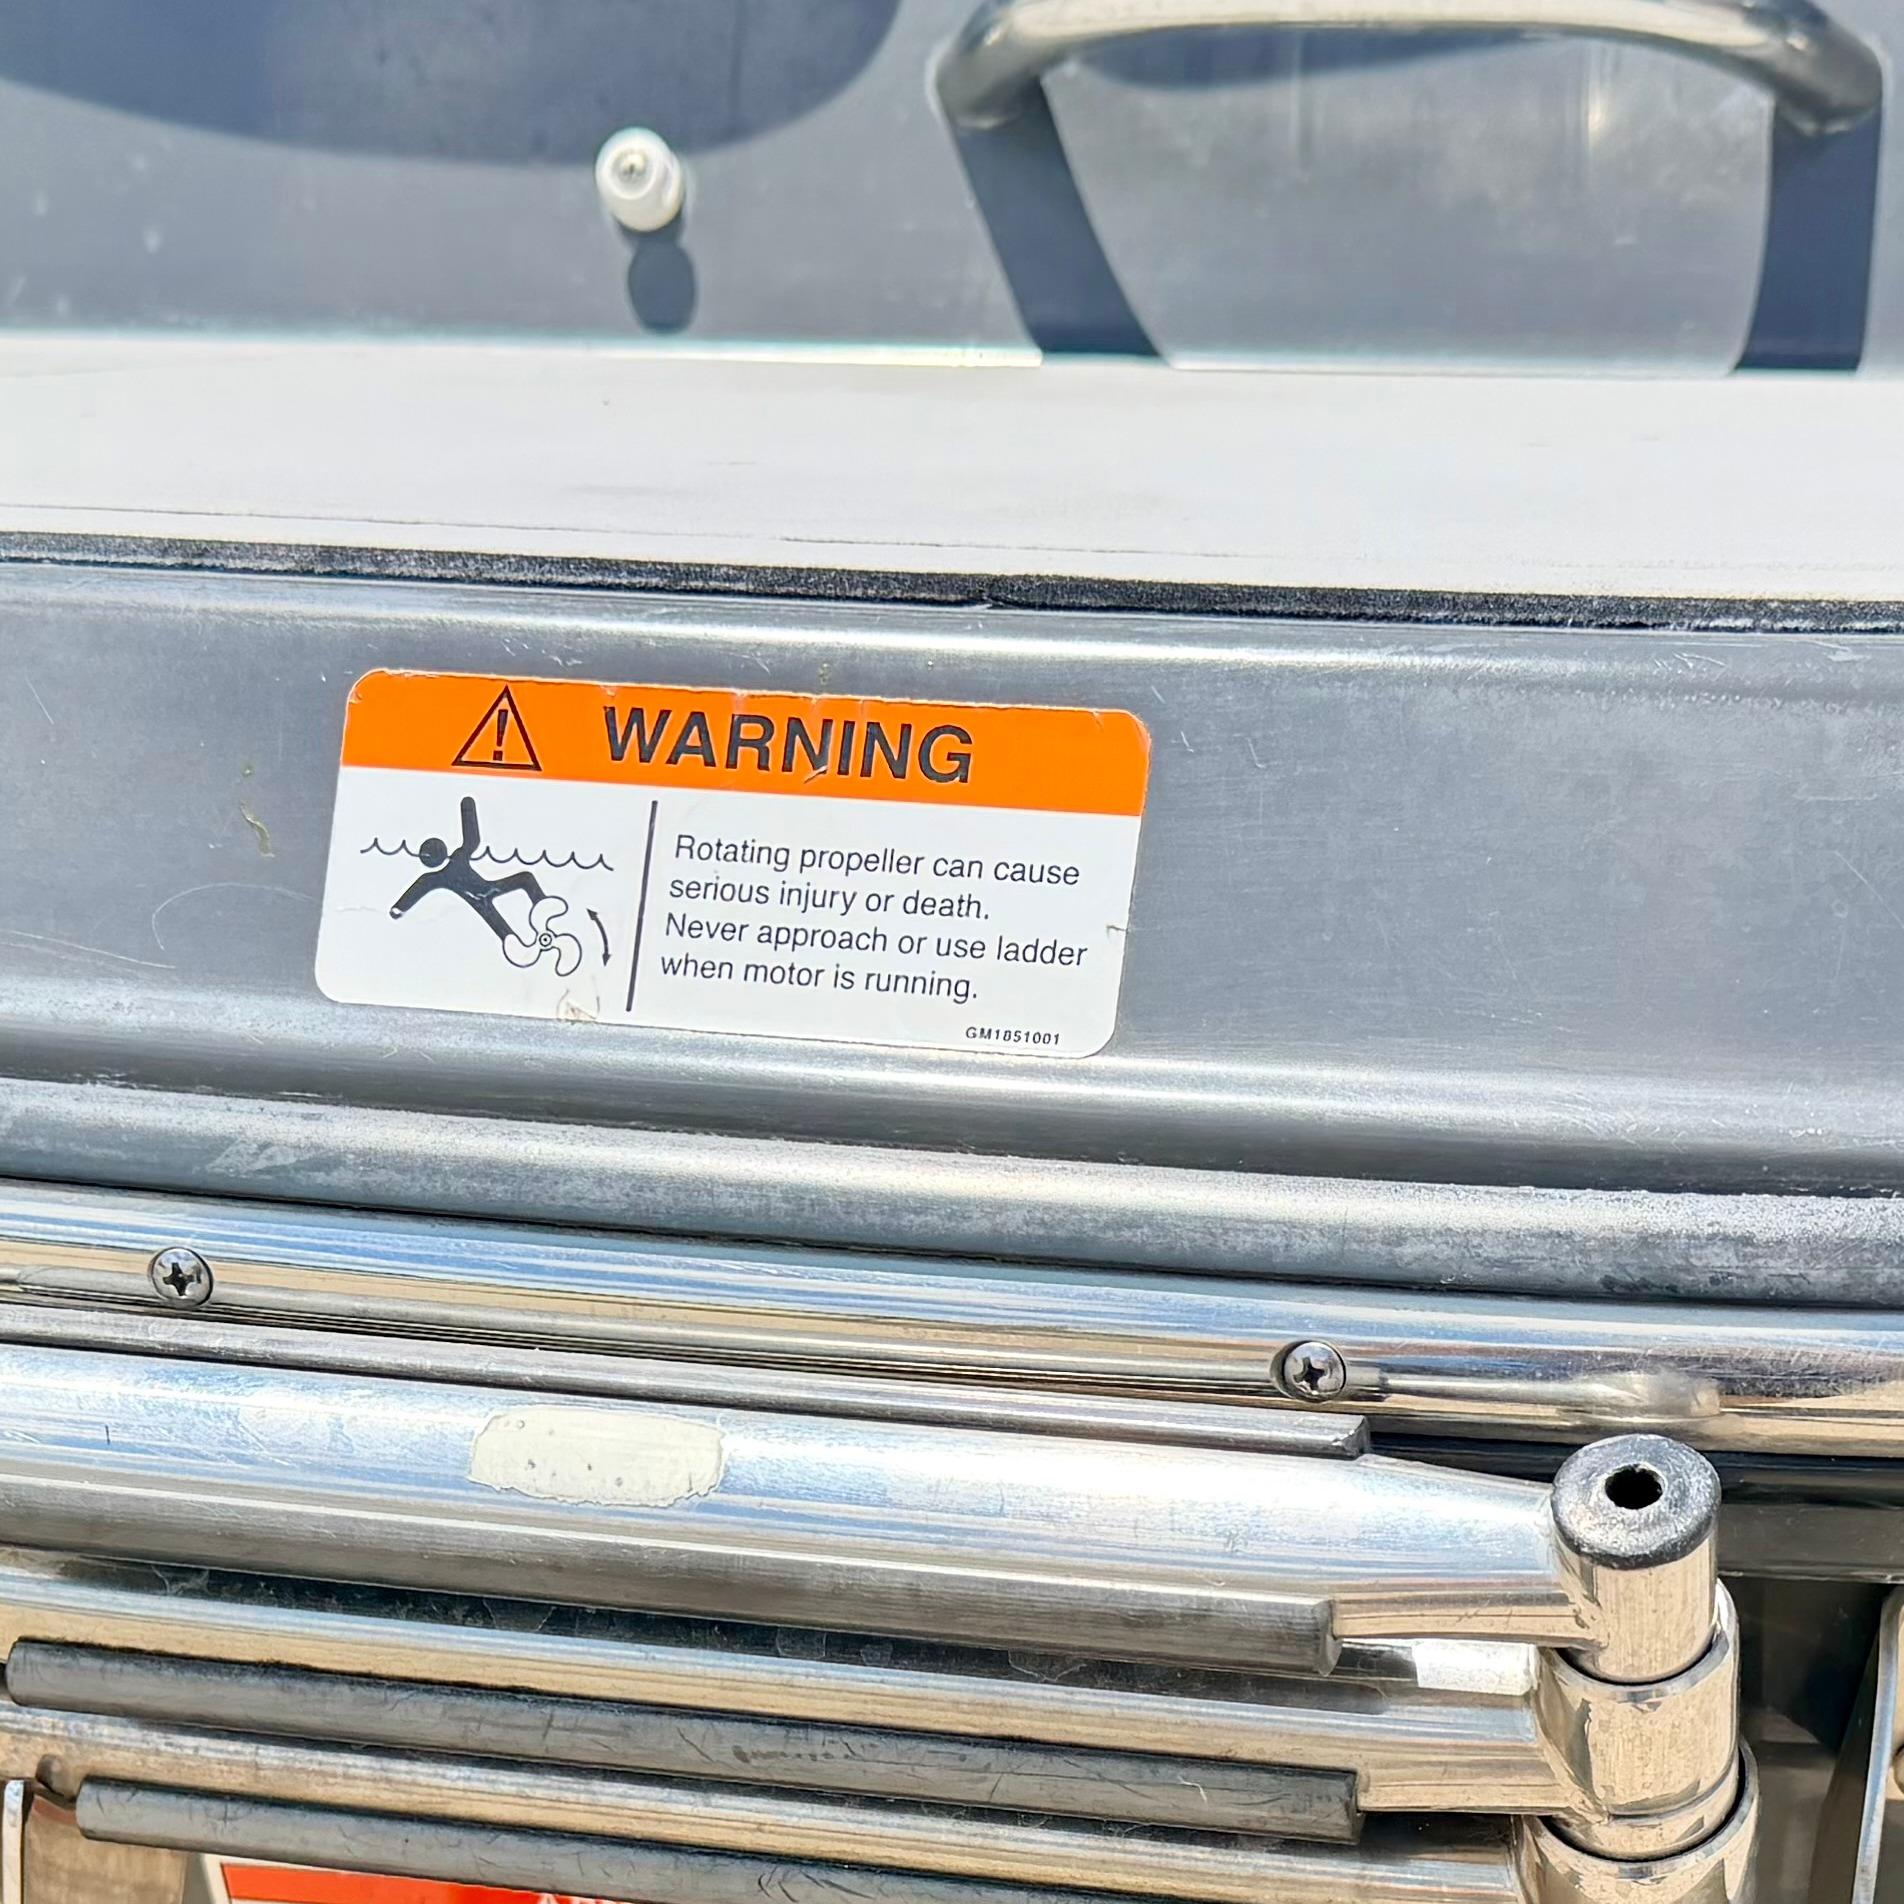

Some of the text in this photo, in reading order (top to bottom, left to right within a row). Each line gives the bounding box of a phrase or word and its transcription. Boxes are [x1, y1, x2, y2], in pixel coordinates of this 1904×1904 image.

[603, 705, 973, 784] WARNING
[675, 834, 1079, 885] Rotating propeller can cause
[670, 876, 988, 919] serious injury or death.
[666, 912, 1088, 966] Never approach or use ladder
[661, 953, 976, 1004] when motor is running.
